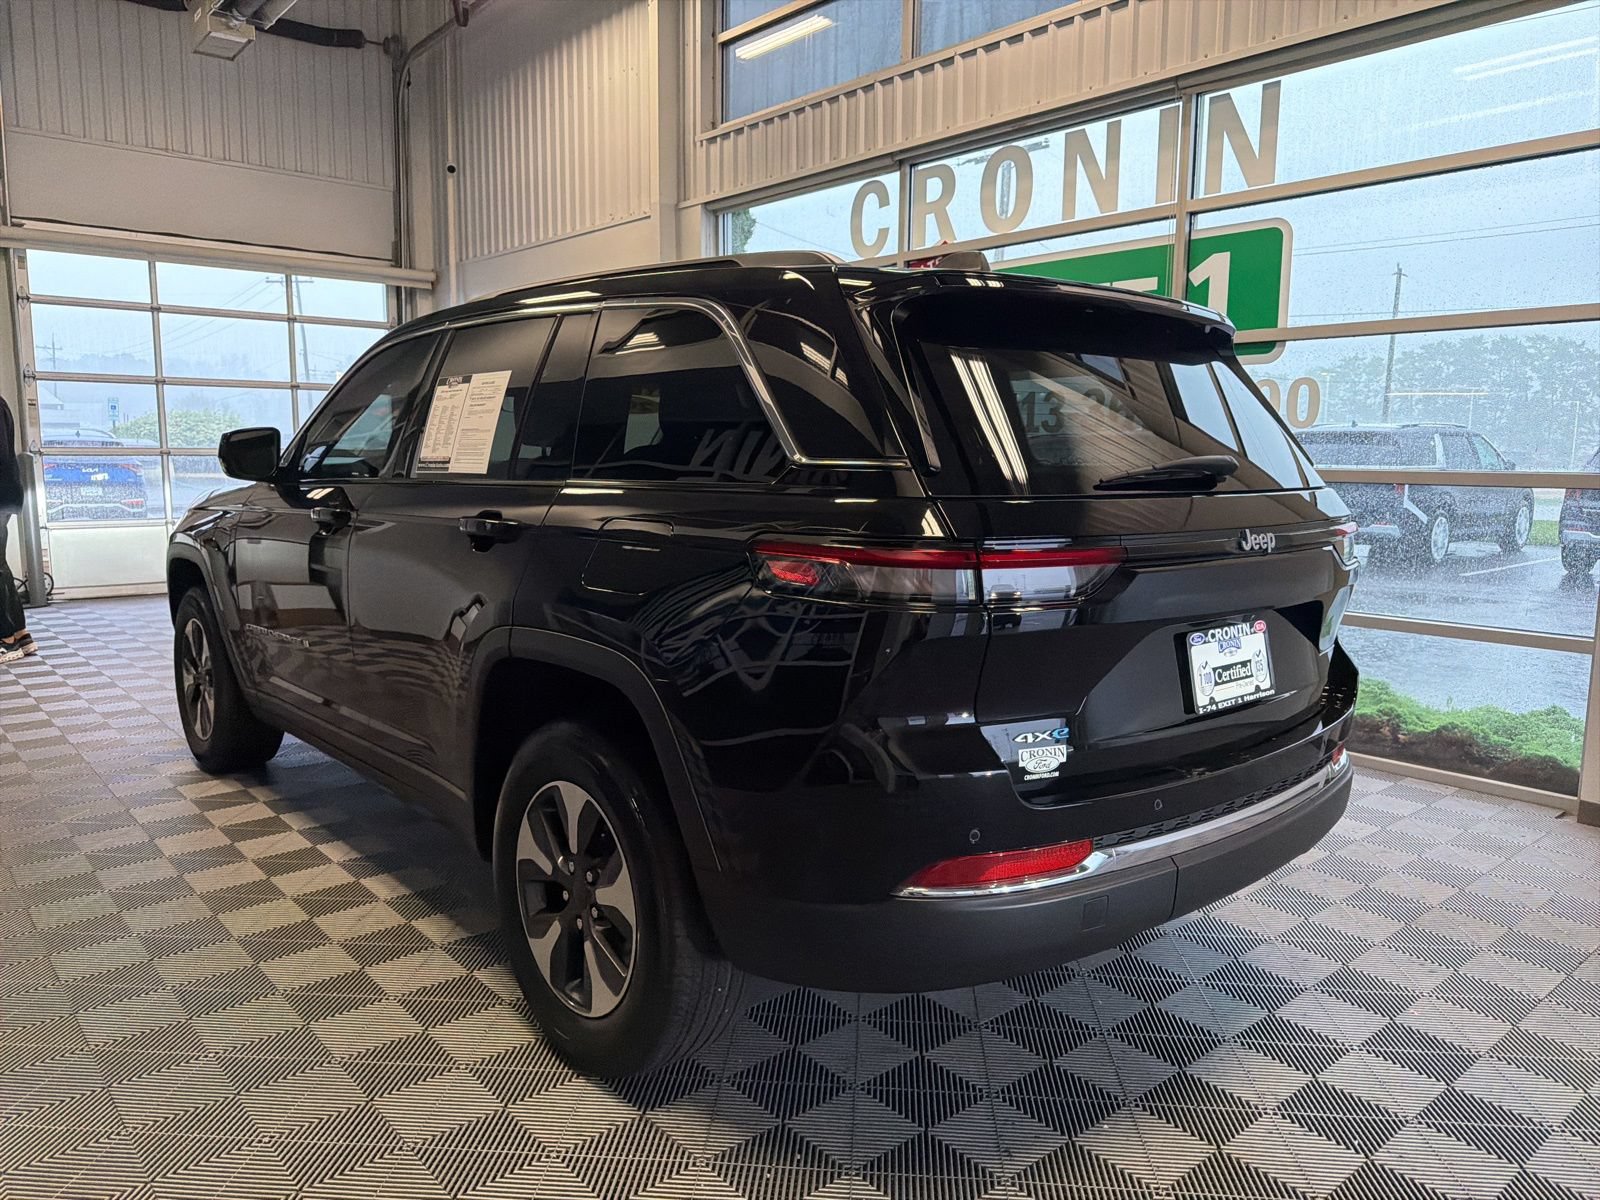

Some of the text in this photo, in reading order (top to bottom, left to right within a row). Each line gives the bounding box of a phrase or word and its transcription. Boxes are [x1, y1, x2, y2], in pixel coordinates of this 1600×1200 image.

[850, 80, 1281, 258] CRONIN
[1241, 528, 1275, 552] Jeep
[1208, 623, 1250, 641] CRONIN
[1215, 663, 1252, 682] Certified
[1199, 704, 1217, 714] I-74
[1218, 699, 1236, 709] EXIT
[1244, 689, 1275, 702] Harrison
[1020, 747, 1065, 762] CRONIN
[1033, 758, 1052, 770] Ford
